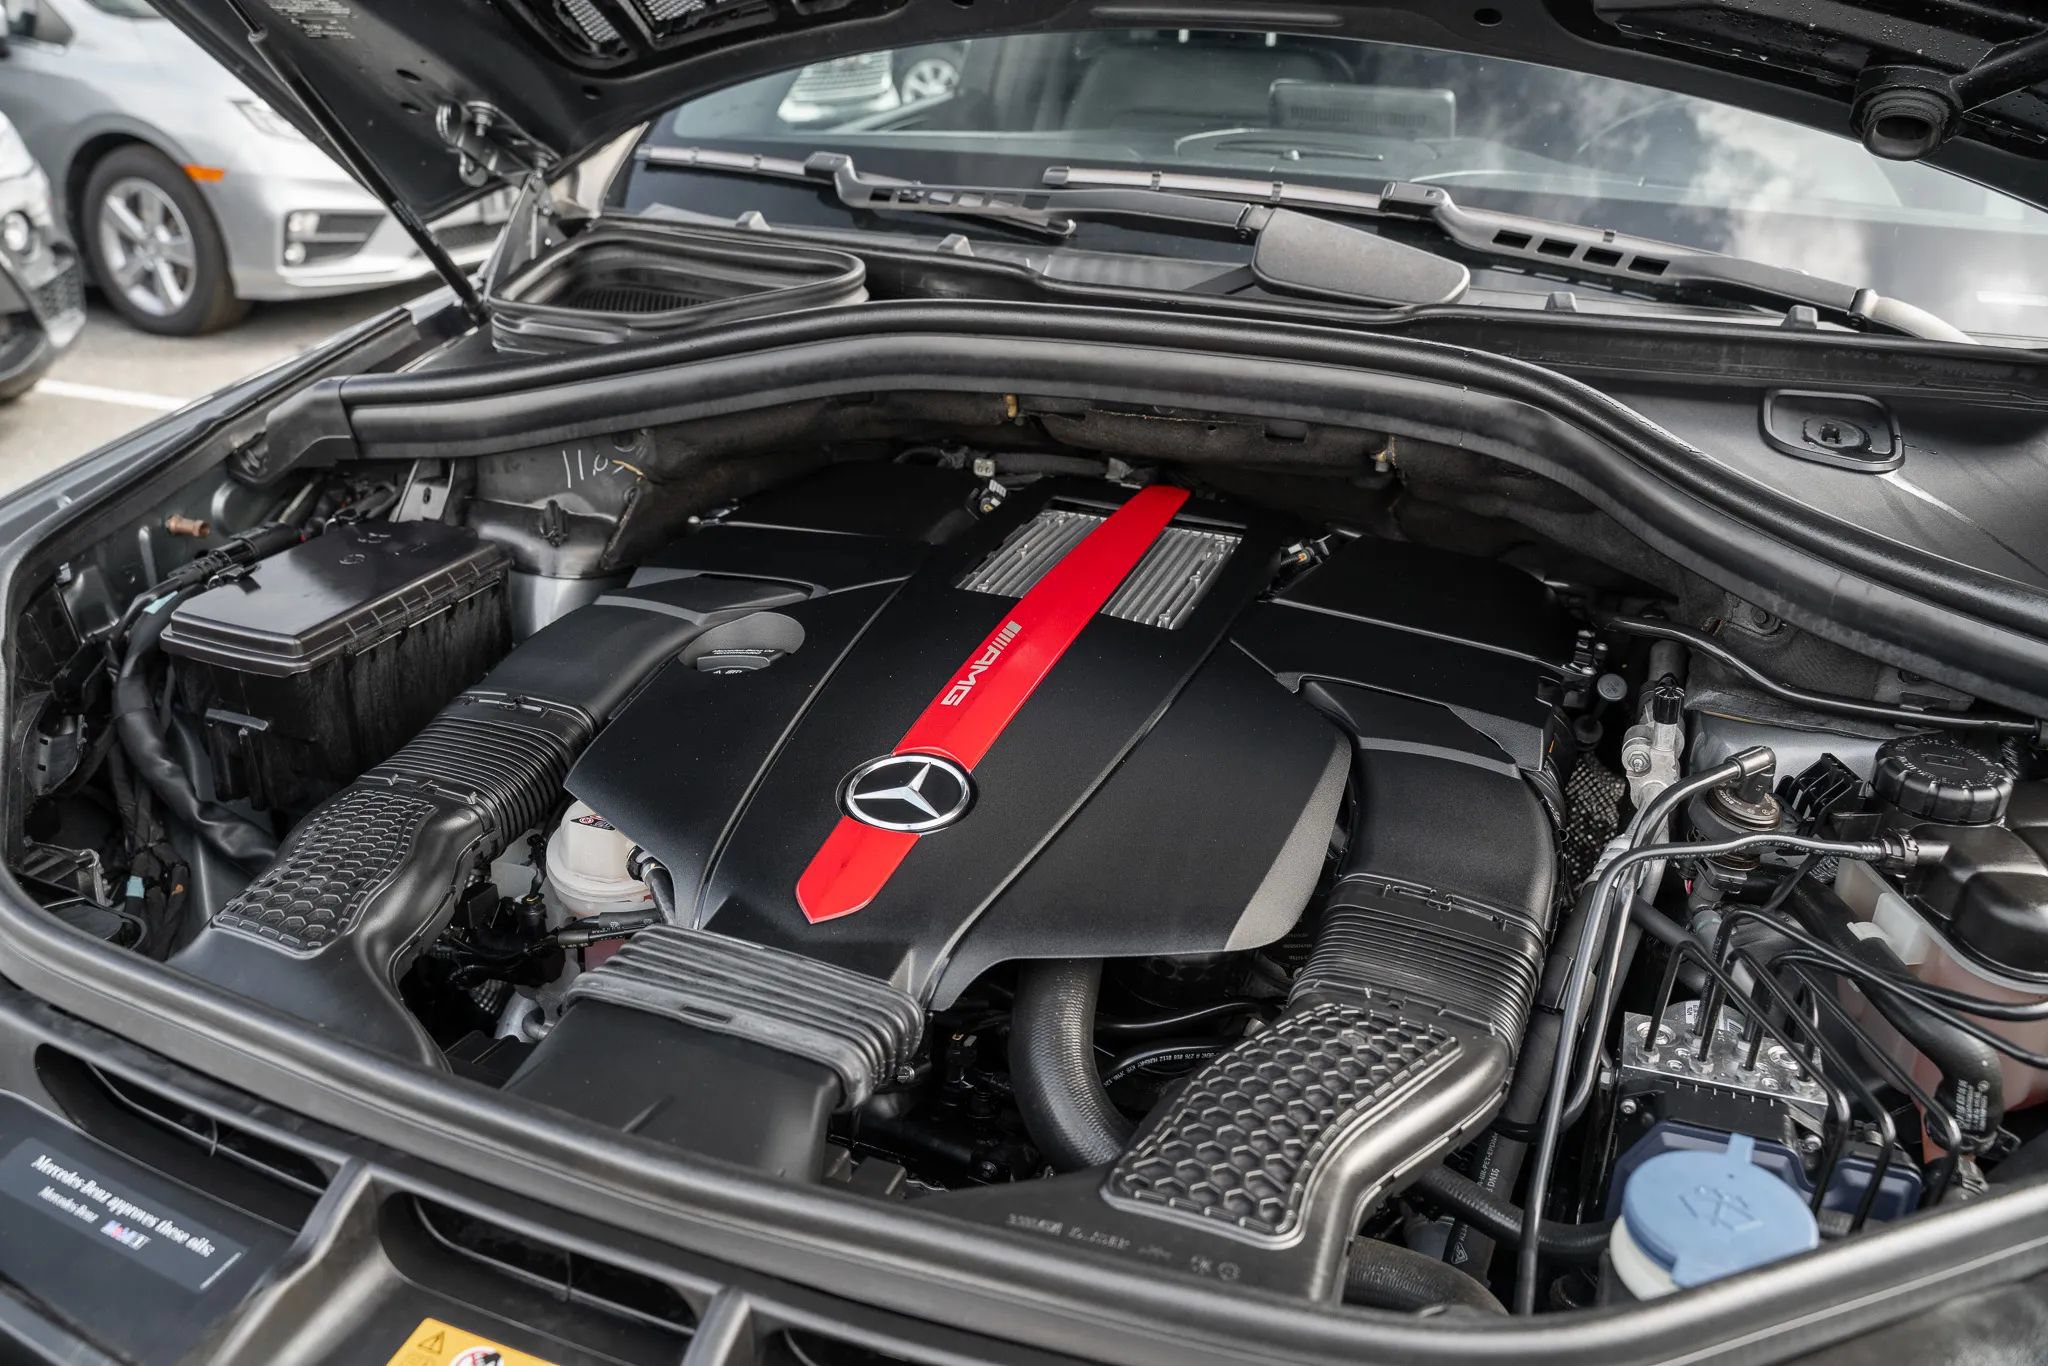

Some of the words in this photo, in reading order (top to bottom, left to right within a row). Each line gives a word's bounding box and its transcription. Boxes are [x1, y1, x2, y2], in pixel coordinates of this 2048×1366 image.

[940, 645, 1001, 706] AMG
[31, 1154, 112, 1203] Mercedes-Benz
[106, 1196, 160, 1228] approves
[154, 1219, 190, 1244] these
